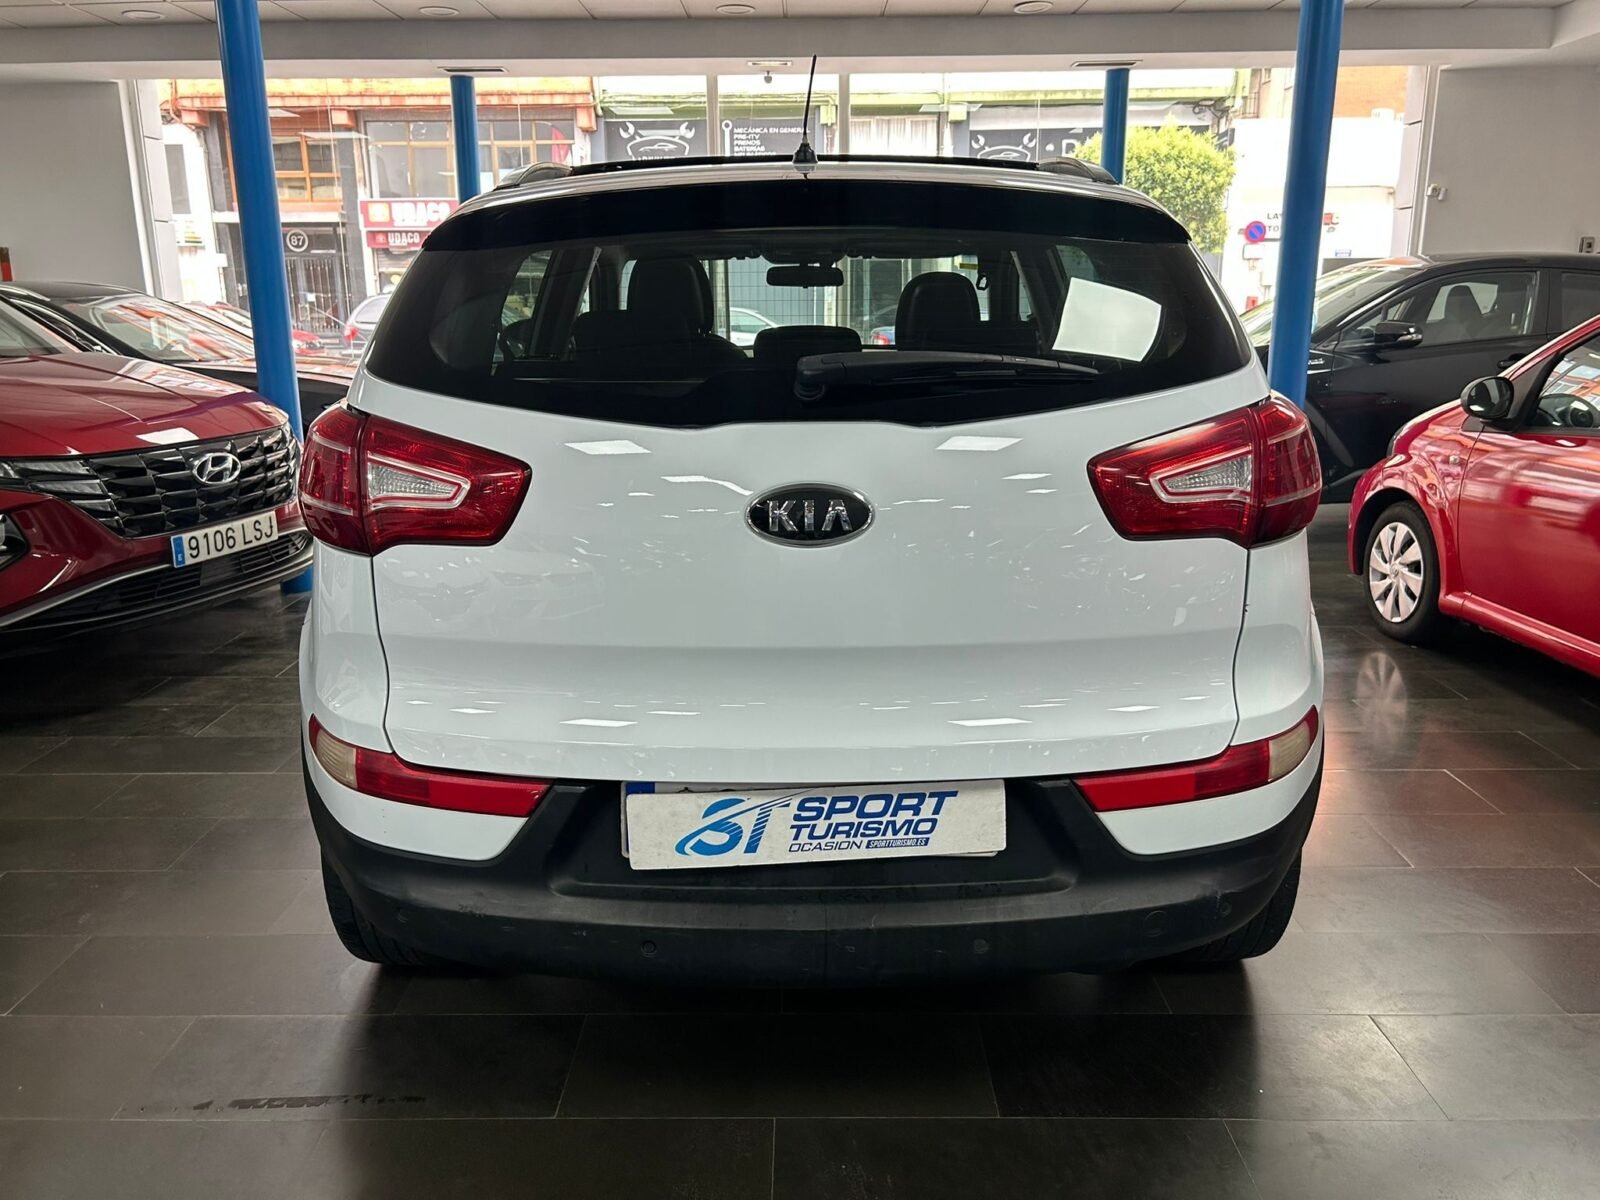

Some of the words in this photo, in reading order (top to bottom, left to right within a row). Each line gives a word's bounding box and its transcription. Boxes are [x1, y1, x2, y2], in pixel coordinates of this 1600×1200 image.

[290, 235, 304, 246] 87
[387, 232, 421, 244] UDACO
[766, 499, 854, 532] KIA
[188, 526, 237, 559] 9106
[241, 516, 274, 546] LSJ
[792, 790, 959, 822] SPORT
[789, 817, 938, 841] TURISMO
[788, 839, 863, 853] OCASION
[868, 838, 927, 848] SPORTTURISMO.ES
